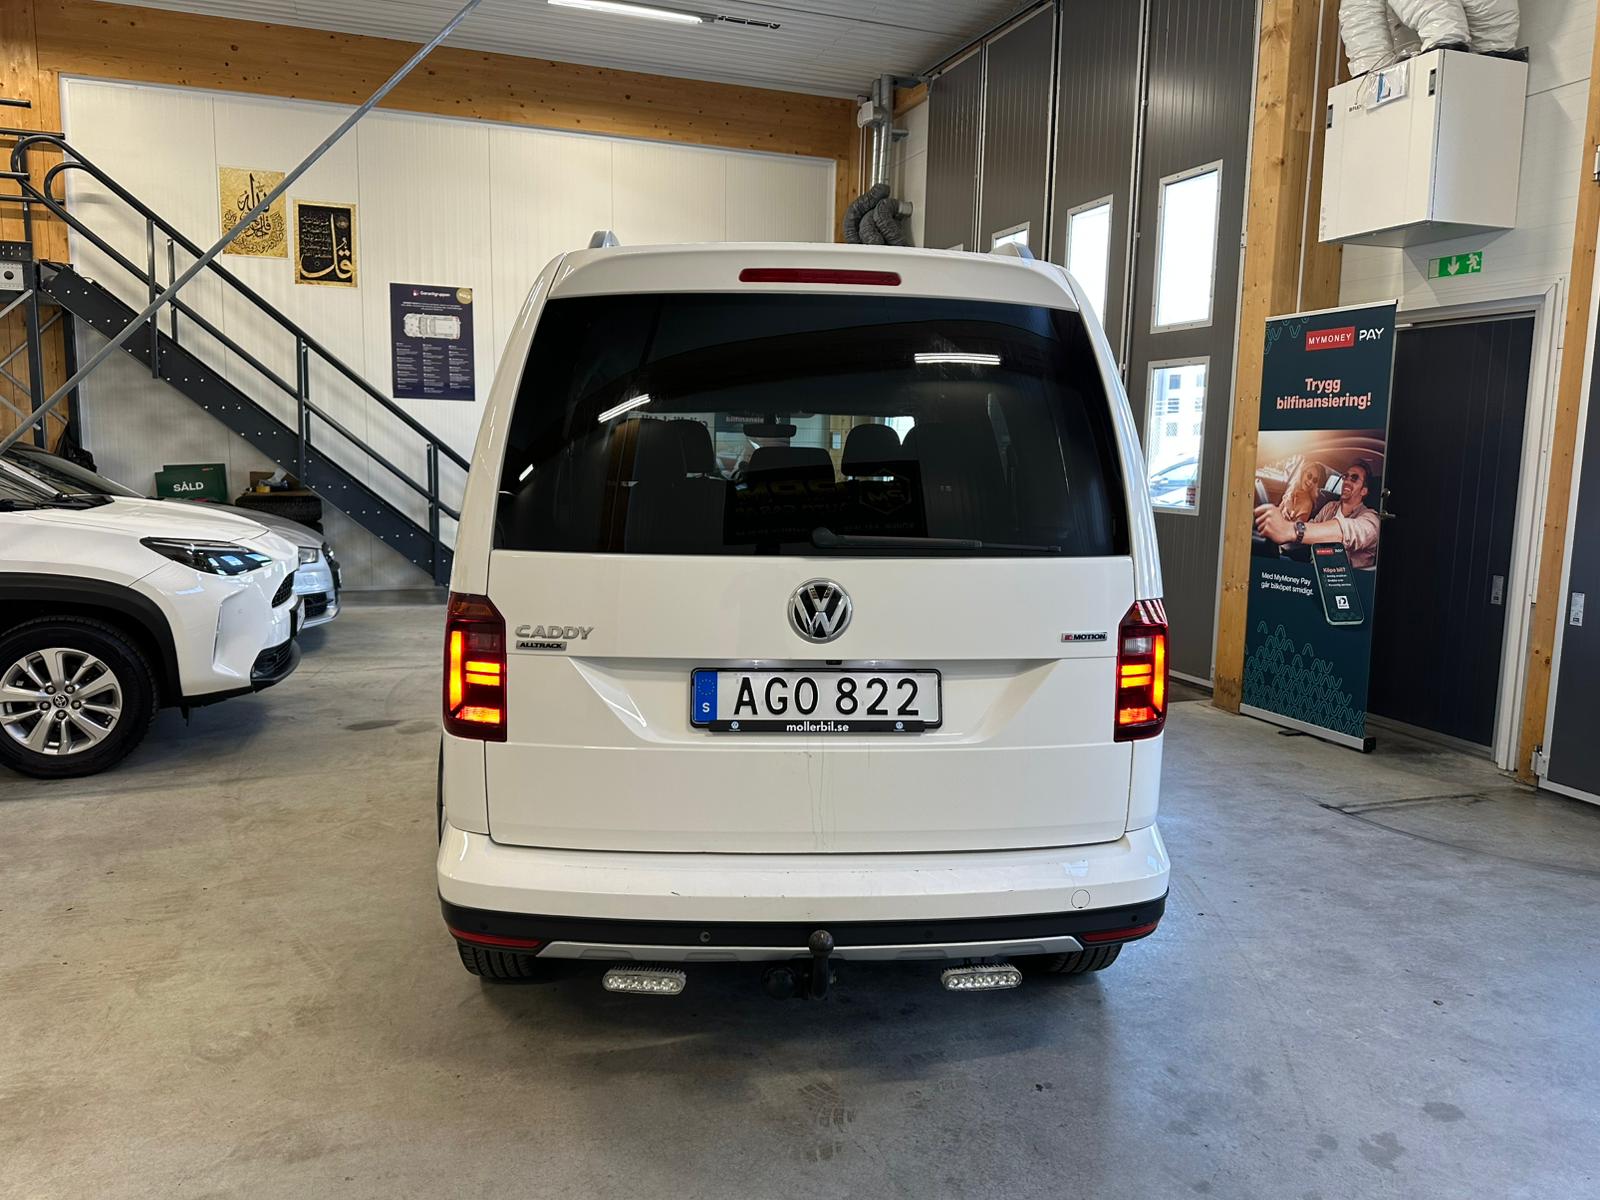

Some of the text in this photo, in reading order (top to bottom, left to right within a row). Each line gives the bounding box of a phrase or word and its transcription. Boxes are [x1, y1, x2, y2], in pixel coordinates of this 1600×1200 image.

[1308, 327, 1384, 345] MYMONEY PAY
[1305, 378, 1341, 394] Trygg
[1276, 392, 1372, 410] bilfinansiering!
[173, 481, 204, 492] SÅLD
[1261, 572, 1311, 586] Med MyMoney Pay
[1261, 581, 1270, 589] går
[1270, 582, 1292, 592] bilköpet
[515, 624, 594, 640] CADDY
[733, 676, 919, 716] AGO 822
[702, 703, 710, 713] S
[786, 721, 849, 733] mollerbil.se
